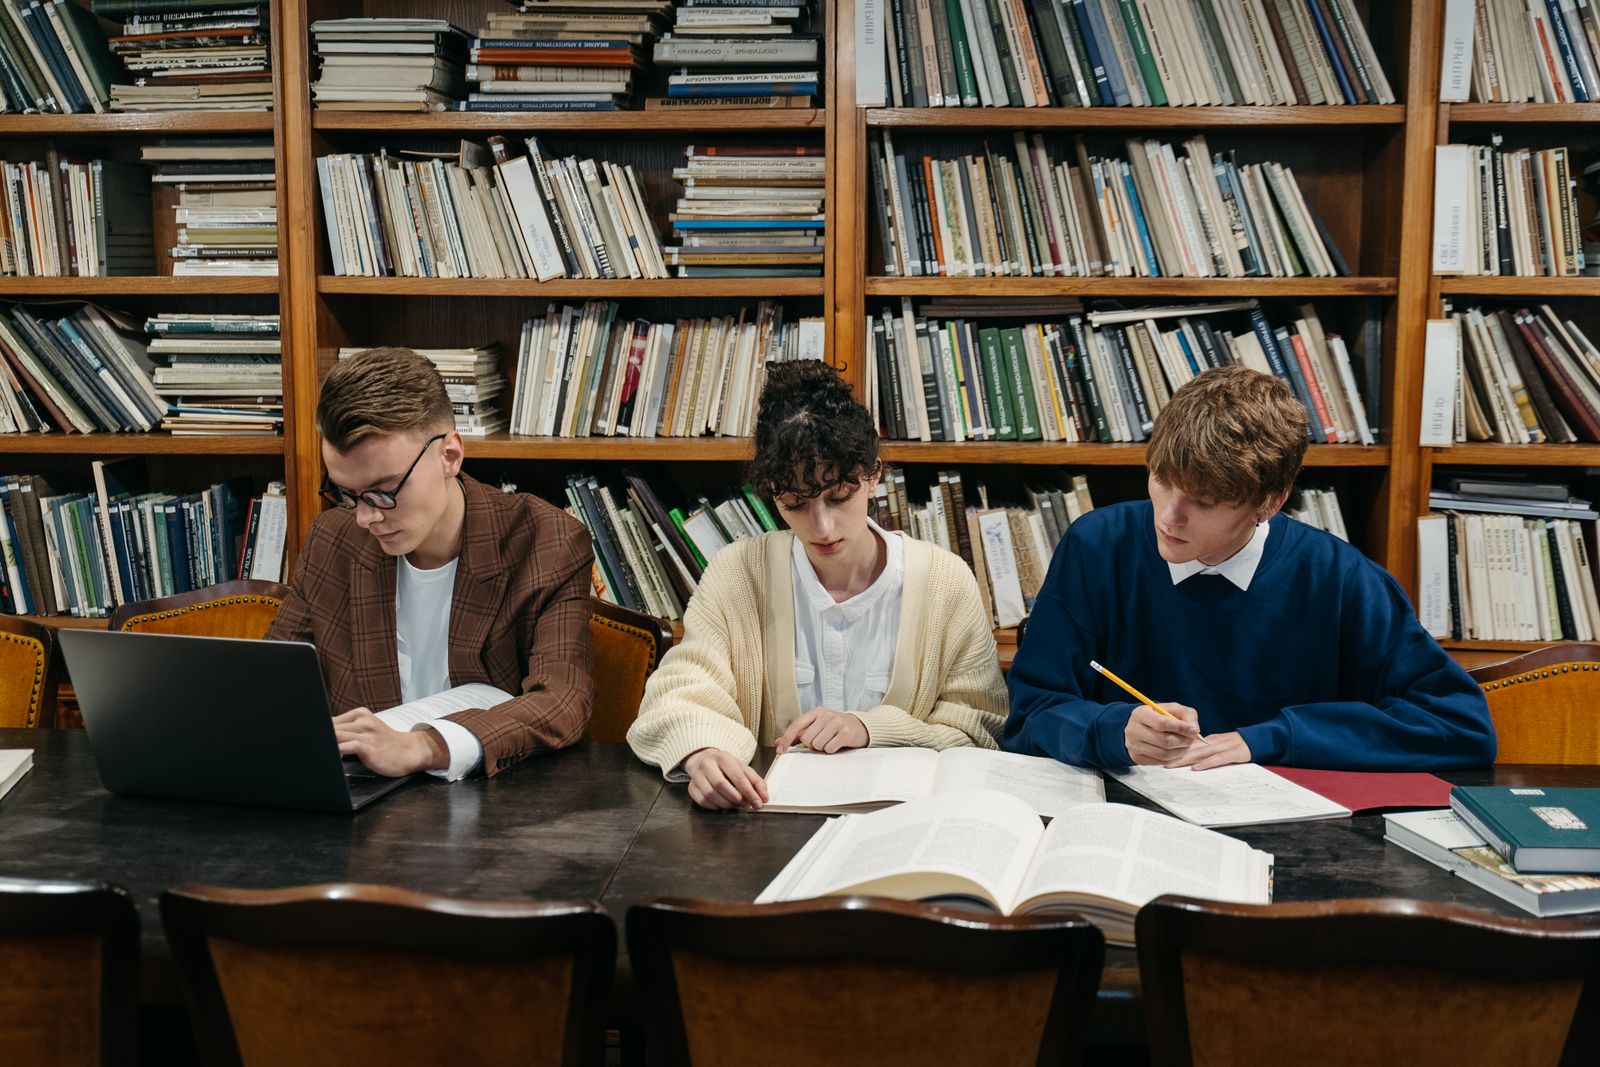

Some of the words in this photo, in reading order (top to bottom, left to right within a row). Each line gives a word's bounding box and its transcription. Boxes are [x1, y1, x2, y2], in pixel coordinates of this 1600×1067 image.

[1452, 35, 1463, 89] ИНТЕРЬЕР
[1256, 320, 1284, 374] СТРОИТЕЛЬНЫЕ
[244, 547, 253, 569] МОСТЫ
